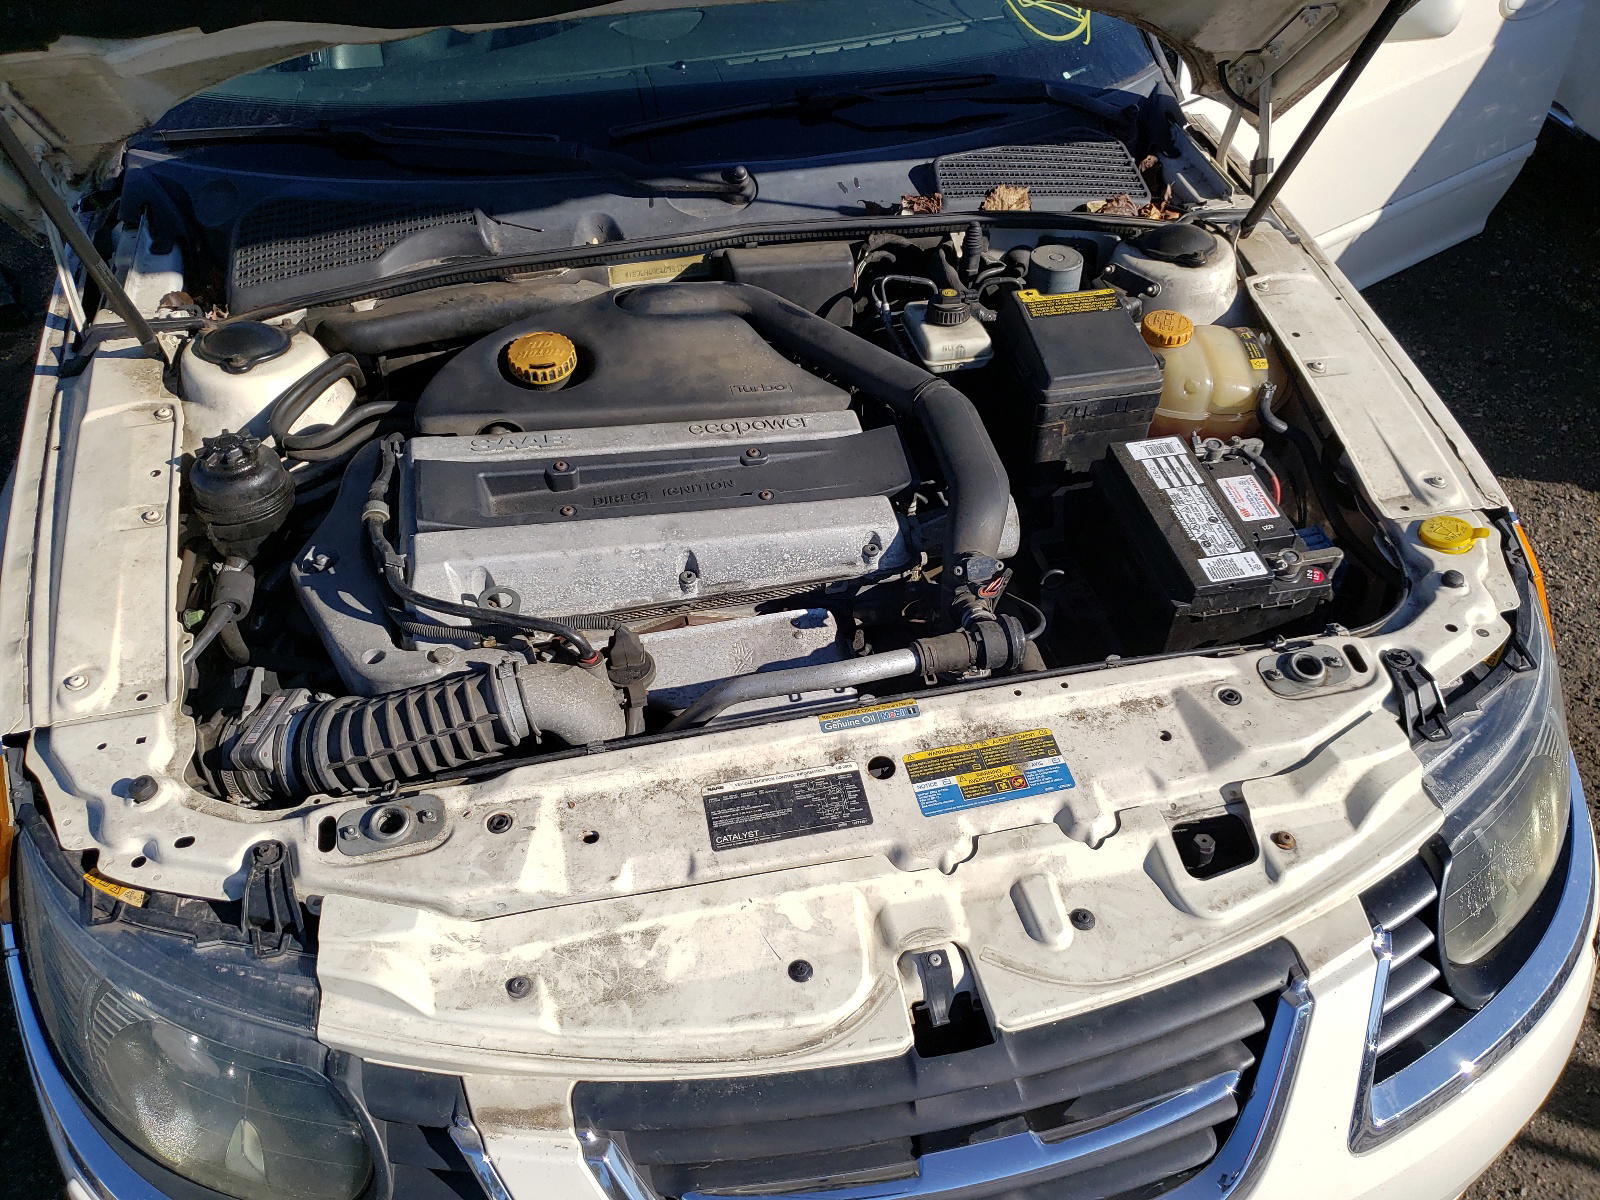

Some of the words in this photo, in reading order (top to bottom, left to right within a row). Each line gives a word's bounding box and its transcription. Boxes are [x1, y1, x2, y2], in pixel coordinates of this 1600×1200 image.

[688, 417, 806, 435] ecopower
[593, 491, 649, 506] DIRECT
[662, 479, 736, 497] IGNITION
[824, 717, 861, 730] Genuine
[862, 715, 876, 724] Oil
[916, 781, 938, 789] NOTICE
[715, 829, 760, 843] CATALYST
